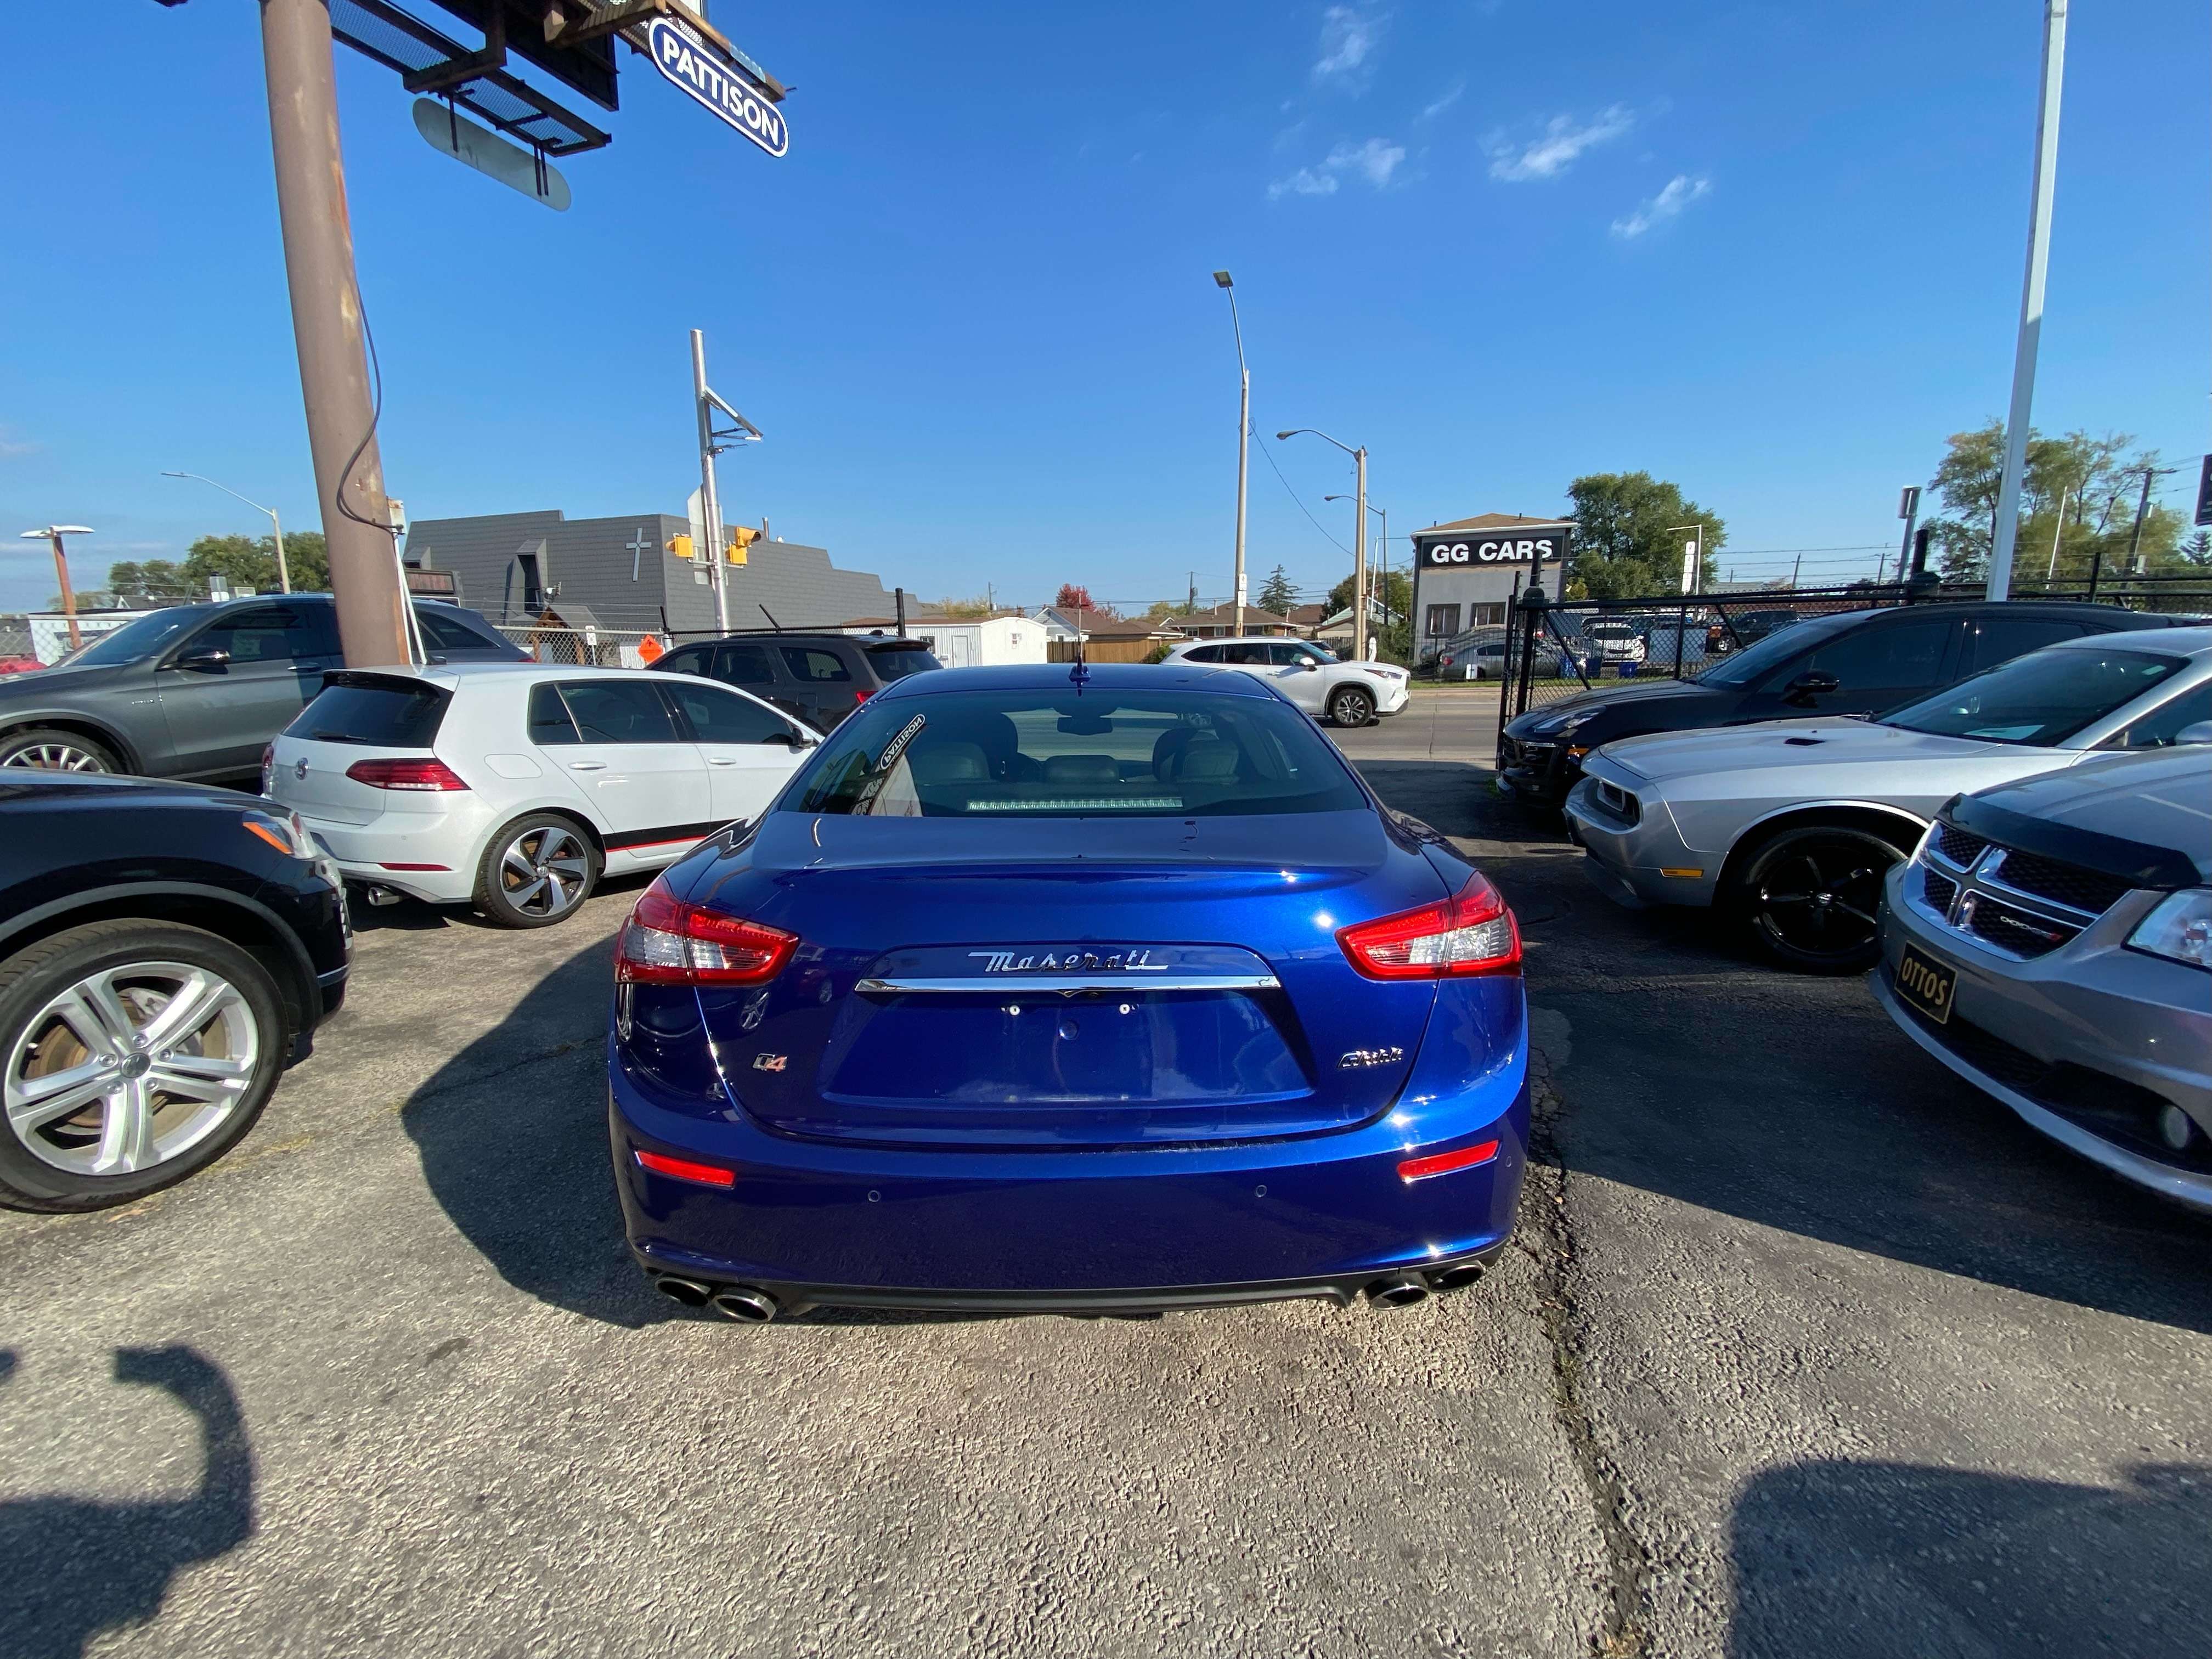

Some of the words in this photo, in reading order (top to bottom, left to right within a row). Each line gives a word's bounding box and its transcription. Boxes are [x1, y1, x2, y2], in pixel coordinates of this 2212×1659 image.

[663, 32, 778, 146] PATTISON
[1431, 544, 1469, 563] GG
[1479, 539, 1552, 561] CARS
[968, 950, 1169, 972] Maserati
[1901, 957, 1948, 1005] OTTOS
